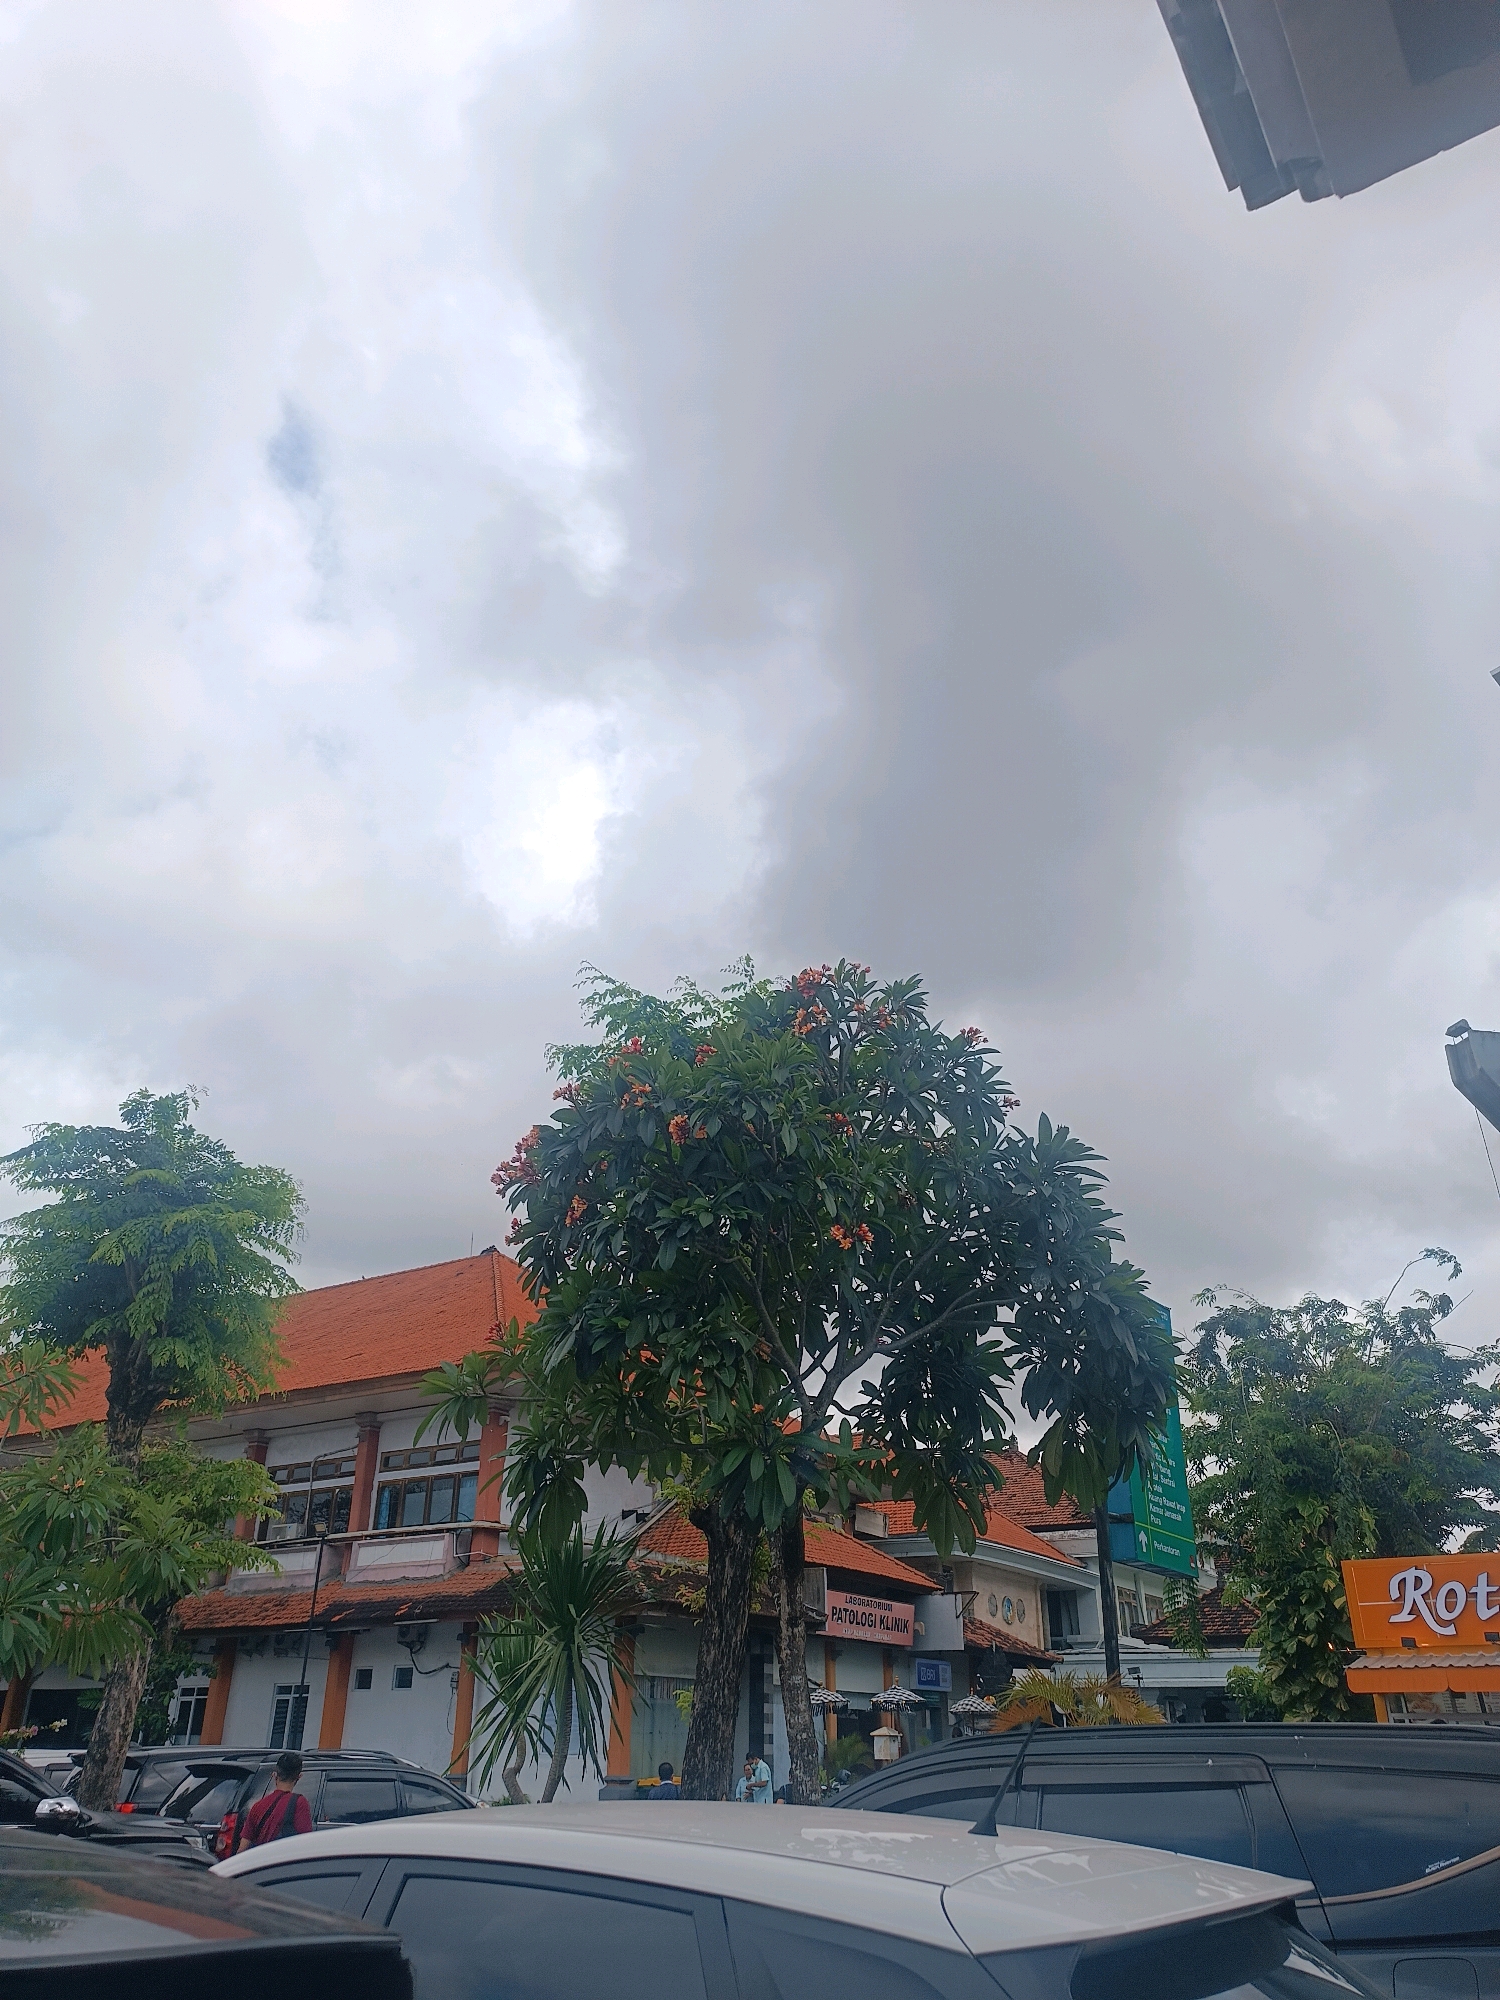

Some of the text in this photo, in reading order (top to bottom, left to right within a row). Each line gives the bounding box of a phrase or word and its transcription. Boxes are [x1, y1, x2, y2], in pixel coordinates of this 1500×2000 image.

[1148, 1480, 1163, 1493] Aotek
[1148, 1491, 1163, 1506] Ruang
[1163, 1496, 1176, 1509] Rawat
[1149, 1503, 1163, 1515] Kamar
[1150, 1514, 1161, 1525] Pura
[1153, 1540, 1180, 1556] Perkantoran
[845, 1595, 893, 1612] LABORATORIUM
[831, 1606, 910, 1634] PATOLOGI KLINIK
